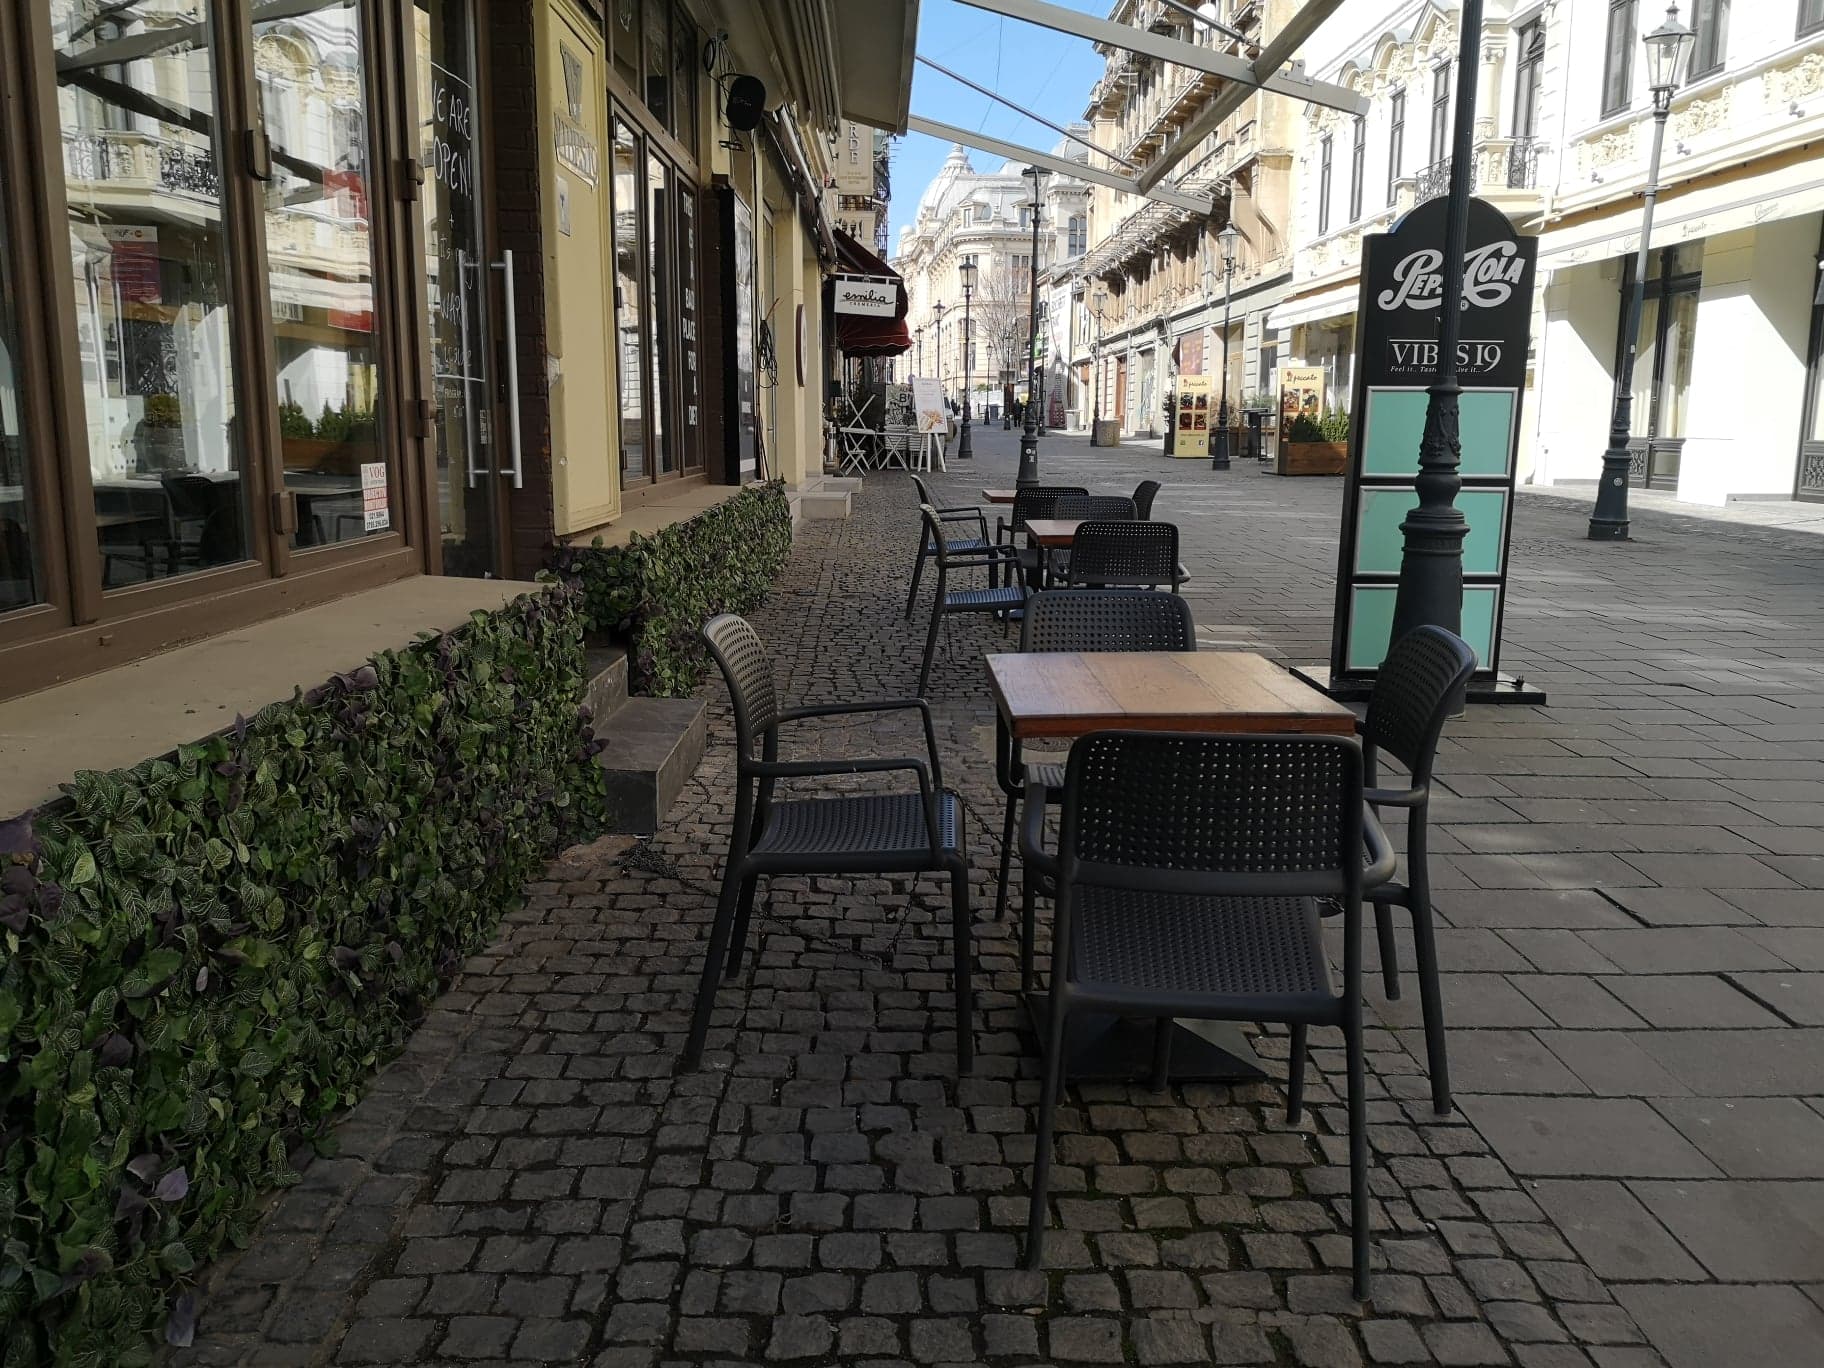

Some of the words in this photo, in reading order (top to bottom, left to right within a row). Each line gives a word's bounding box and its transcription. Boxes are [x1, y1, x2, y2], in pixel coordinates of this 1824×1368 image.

[450, 95, 472, 141] ARE
[433, 136, 472, 200] OPEN!
[843, 290, 894, 304] emilia
[1392, 344, 1469, 365] VIBS
[369, 465, 385, 478] VOG
